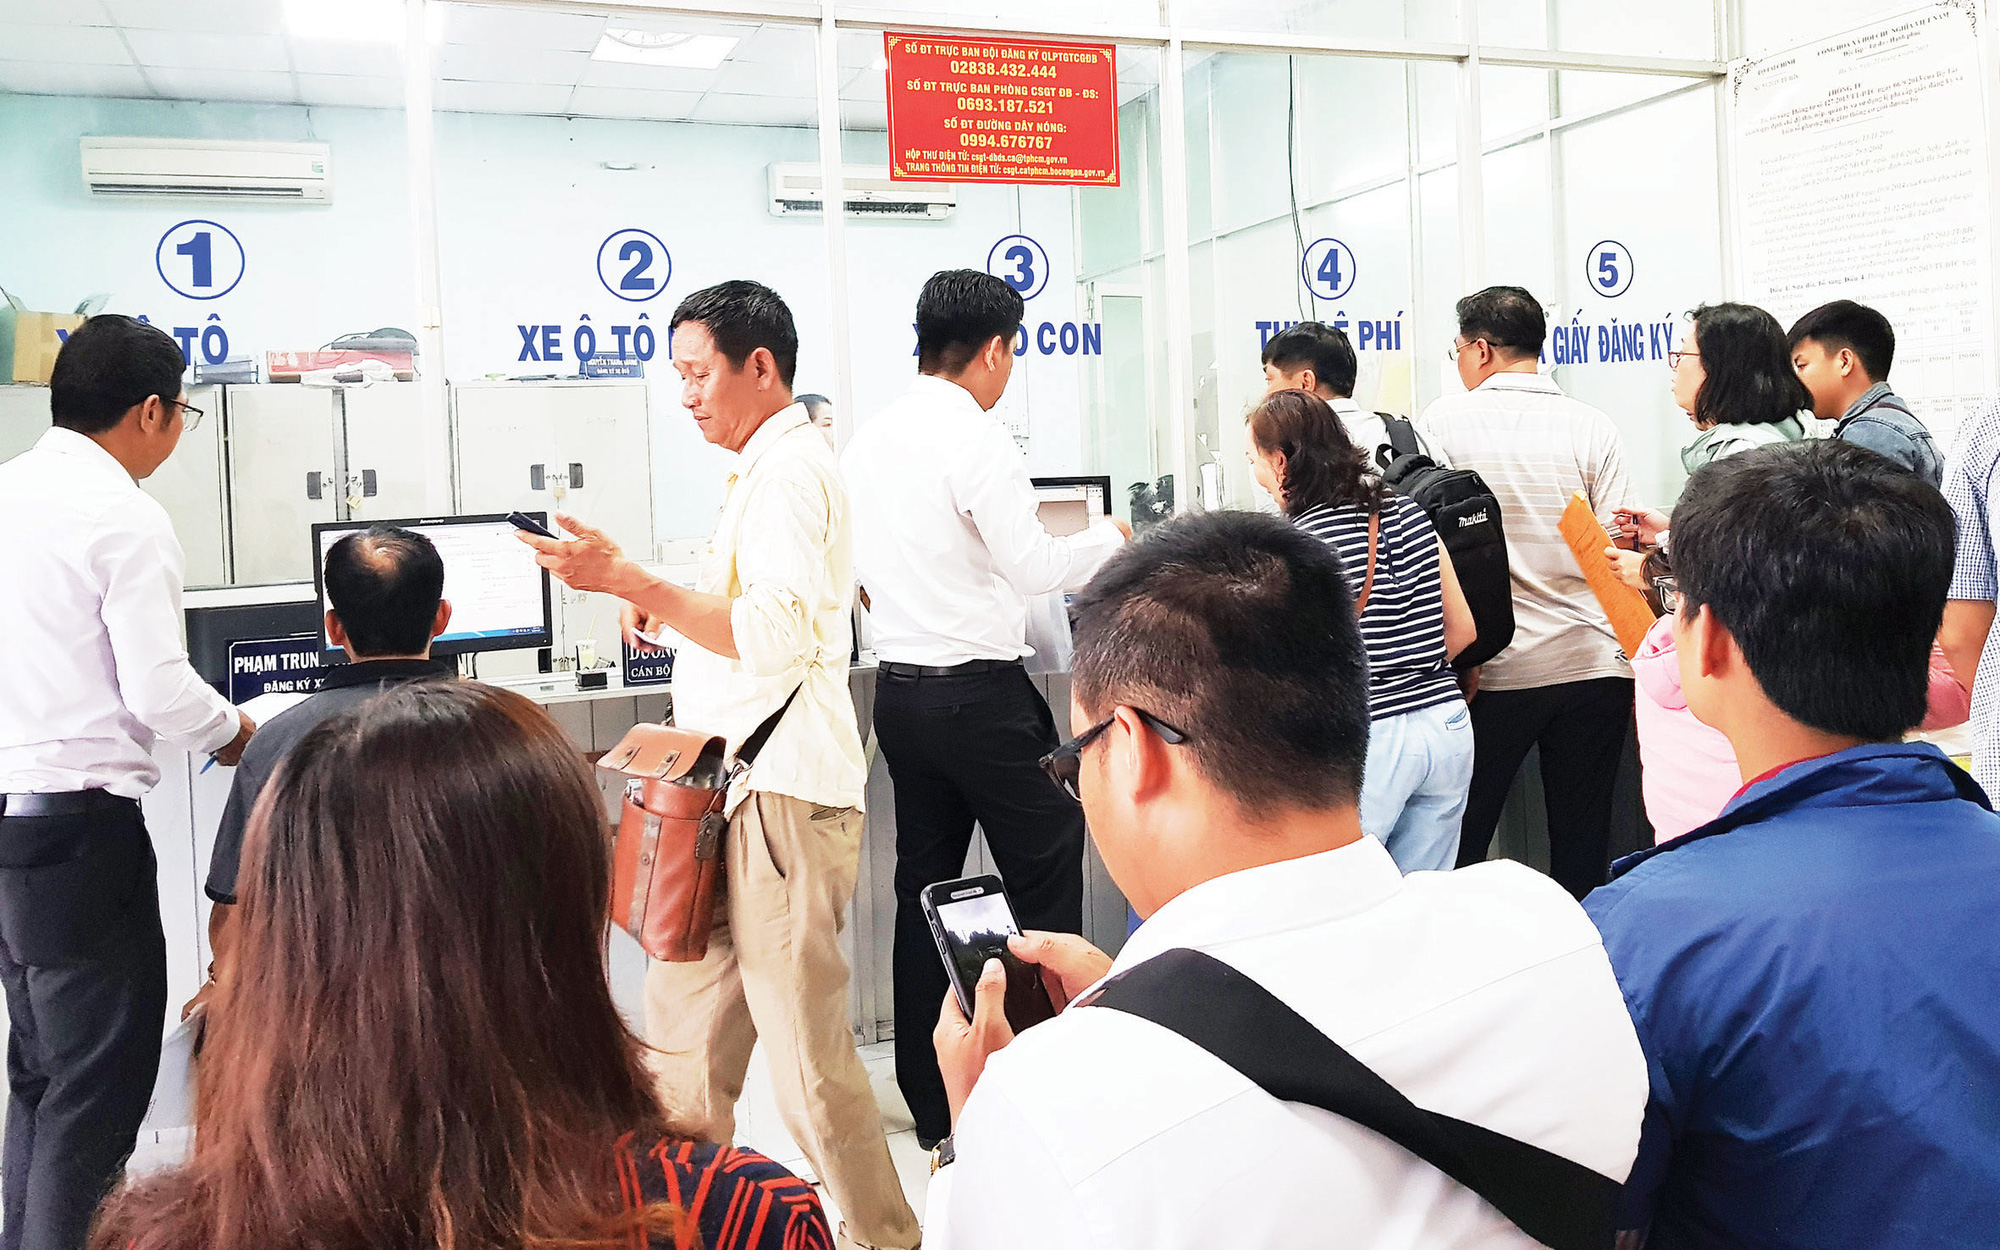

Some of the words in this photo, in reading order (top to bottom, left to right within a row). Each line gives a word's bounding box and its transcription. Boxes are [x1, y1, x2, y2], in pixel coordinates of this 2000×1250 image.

[905, 41, 918, 54] SỐ
[920, 44, 932, 54] ĐT
[934, 45, 959, 58] TRỰC
[962, 47, 980, 57] BAN
[983, 46, 999, 60] ĐỘI
[1001, 47, 1026, 60] ĐĂNG
[1028, 49, 1039, 60] KÝ
[950, 60, 1057, 79] 02838.432.444
[907, 78, 921, 91] SỐ
[923, 81, 937, 91] ĐT
[940, 81, 967, 94] TRỰC
[970, 83, 991, 94] BAN
[994, 83, 1028, 96] PHÒNG
[1031, 86, 1056, 97] CSGT
[1059, 88, 1073, 98] ĐB
[1082, 89, 1099, 99] ĐS:
[957, 97, 1053, 114] 0693.187.521
[944, 116, 958, 129] SỐ
[960, 119, 974, 129] ĐT
[976, 118, 1012, 131] ĐƯỜNG
[1014, 119, 1034, 132] DÂY
[1036, 121, 1067, 133] NÓNG:
[960, 133, 1053, 149] 0994.676767
[905, 147, 921, 161] HỘP
[922, 150, 938, 160] THƯ
[939, 149, 956, 162] ĐIỆN
[957, 149, 970, 161] TỬ:
[906, 162, 930, 172] TRANG
[931, 161, 956, 173] THÔNG
[957, 163, 969, 173] TIN
[971, 162, 988, 175] ĐIỆN
[989, 162, 1002, 174] TỬ:
[177, 232, 212, 287] 1
[619, 240, 655, 290] 2
[1004, 245, 1034, 292] 3
[1317, 248, 1341, 291] 4
[1598, 252, 1618, 288] 5
[173, 313, 229, 366] TÔ
[517, 325, 563, 361] XE
[574, 313, 596, 362] Ô
[611, 312, 655, 362] TÔ
[1037, 321, 1102, 356] CON
[1358, 310, 1404, 351] PHÍ
[1553, 308, 1590, 365] GIẤY
[1598, 317, 1645, 363] ĐĂNG
[1650, 312, 1673, 361] KÝ
[1458, 507, 1488, 528] makita
[234, 654, 277, 676] PHẠM
[280, 651, 325, 671] TRUN
[631, 665, 654, 678] CÁN
[656, 663, 671, 677] BỘ
[263, 680, 293, 693] ĐĂNG
[296, 677, 311, 690] KÝ
